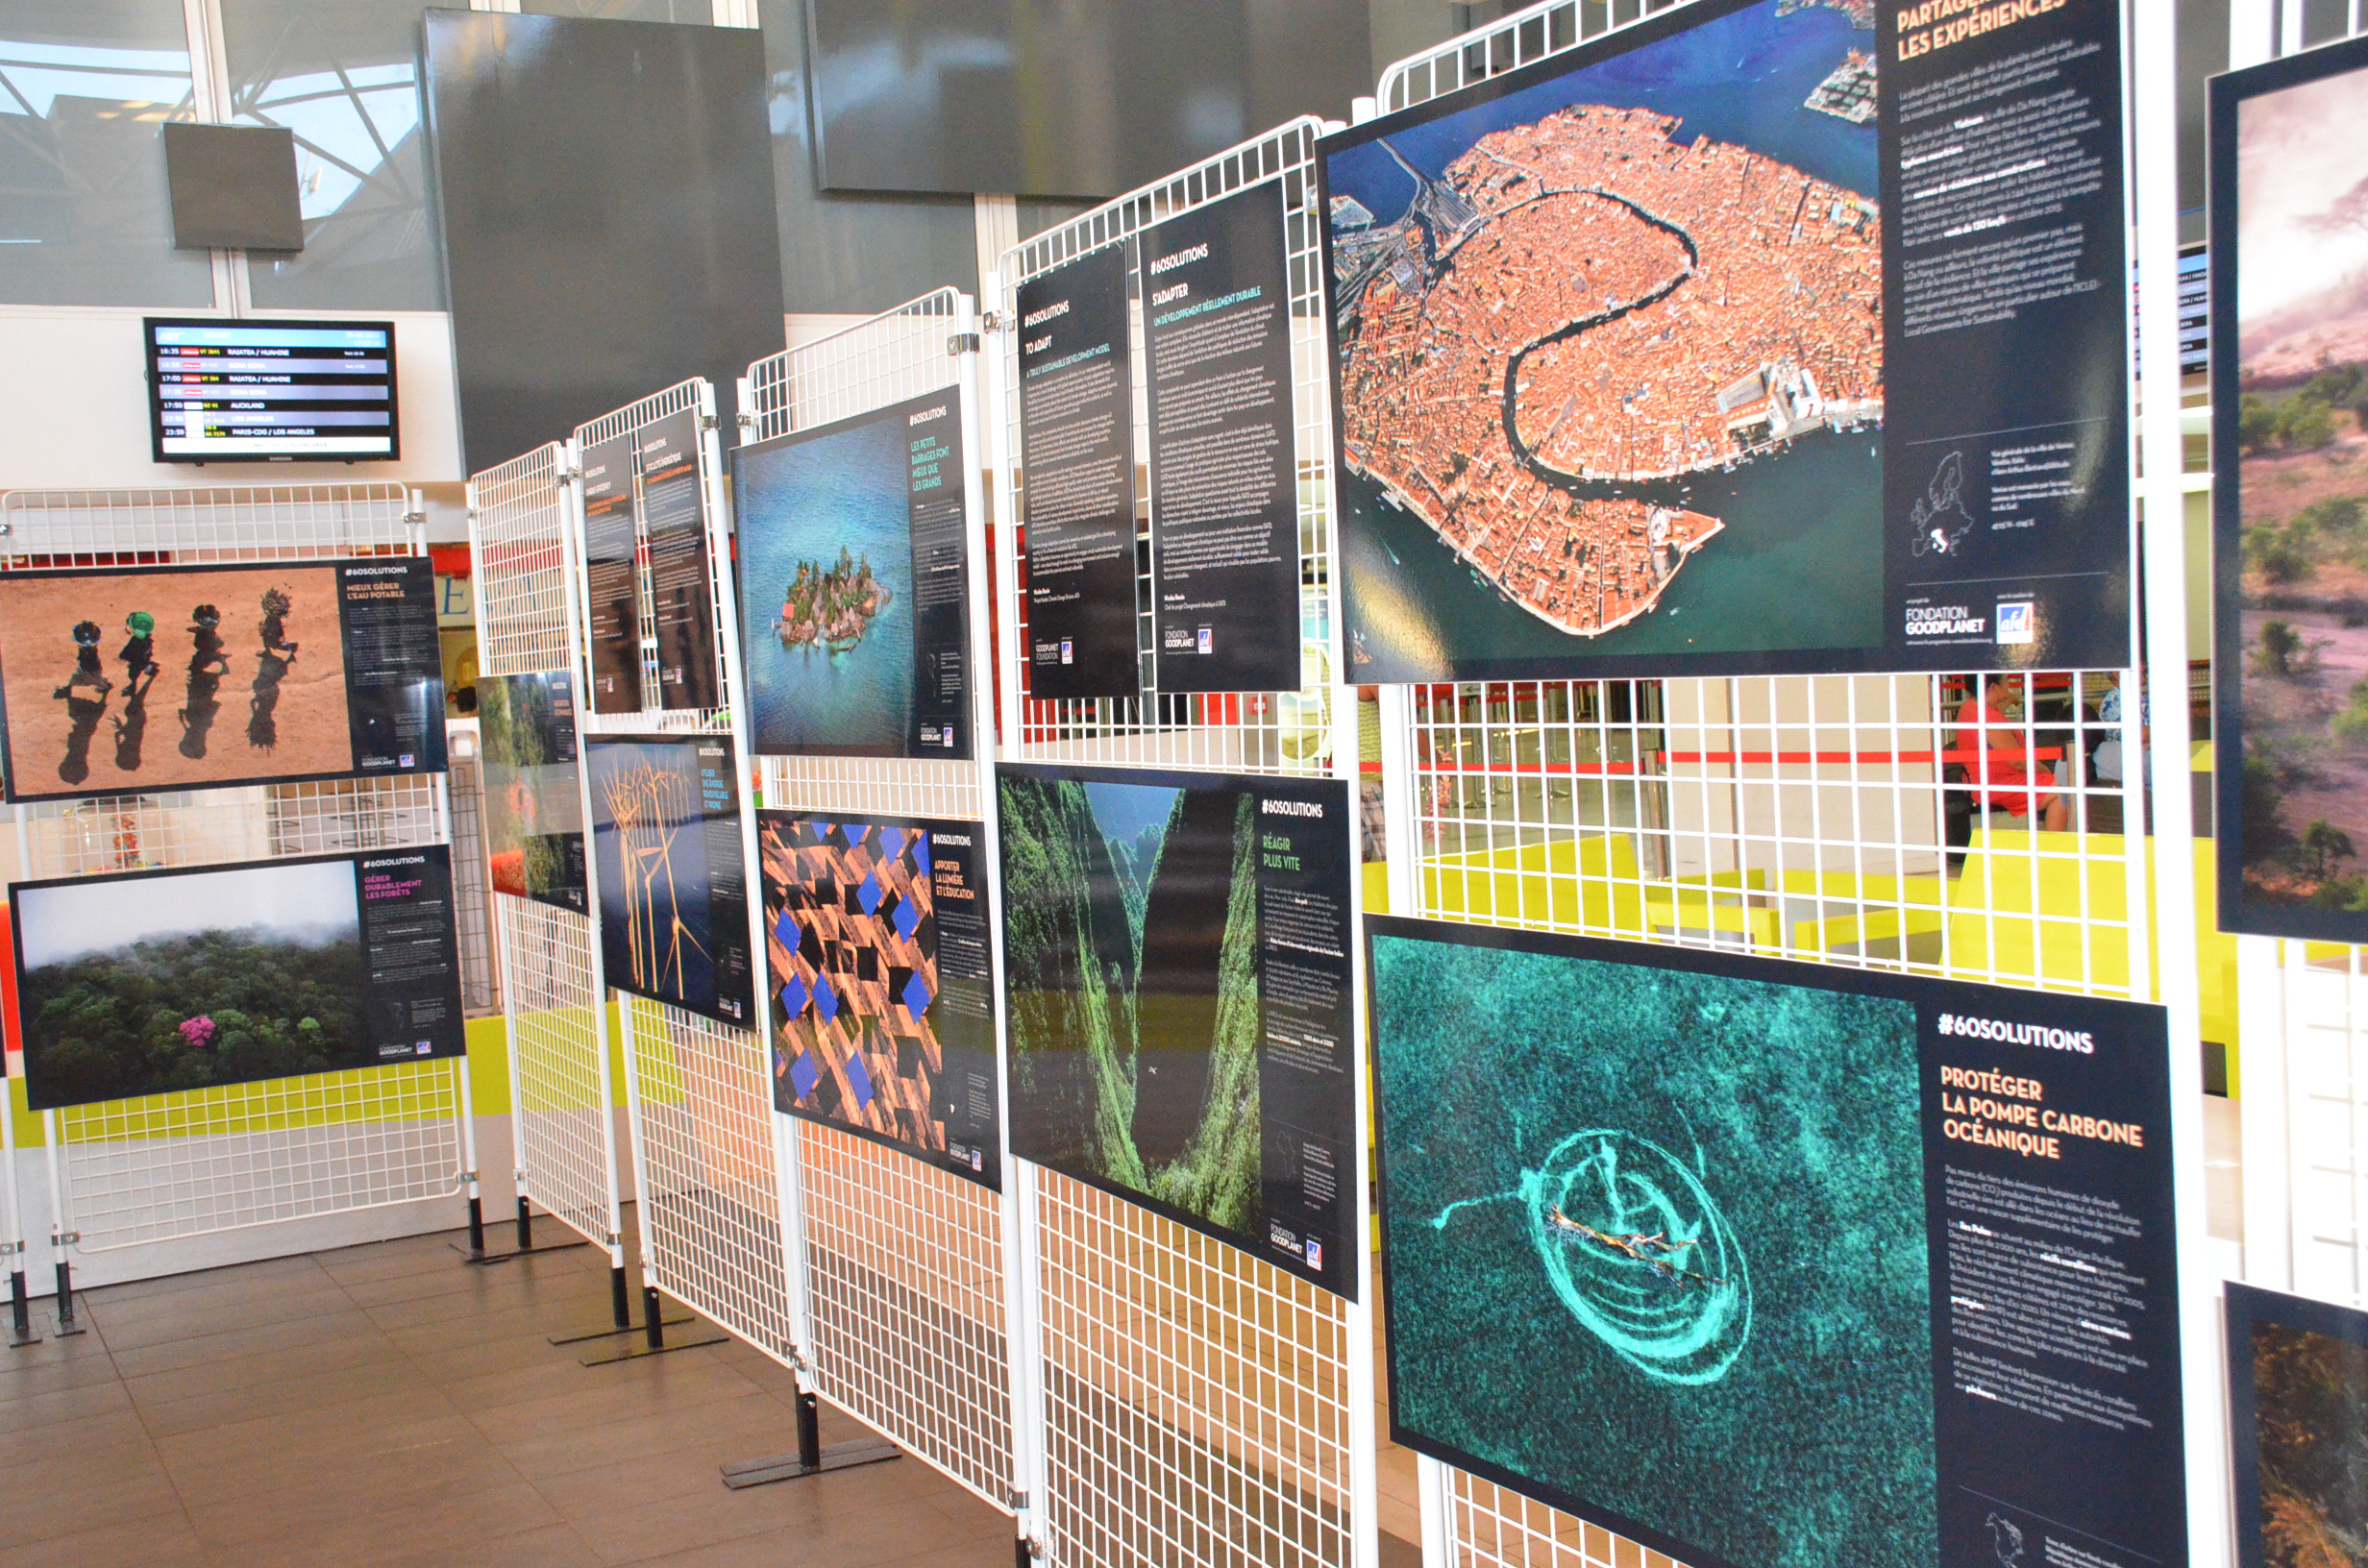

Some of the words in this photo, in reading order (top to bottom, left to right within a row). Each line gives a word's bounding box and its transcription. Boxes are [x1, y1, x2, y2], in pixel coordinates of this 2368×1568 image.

[1897, 0, 1994, 33] PARTAG
[1898, 31, 1931, 61] LES
[1150, 243, 1208, 275] #60SOLUTIONS
[1152, 282, 1189, 306] S'ADAPTER
[1024, 300, 1070, 328] #60SOLUTIONS
[345, 566, 407, 576] #60SOLUTIONS
[1905, 618, 1986, 635] GOODPLANET
[1906, 606, 1968, 622] FONDATION
[1262, 798, 1323, 818] #60SOLUTIONS
[1263, 831, 1291, 852] RÉAGIR
[363, 855, 425, 869] #60SOLUTIONS
[1263, 854, 1282, 869] PLUS
[1283, 856, 1300, 871] VITE
[1937, 1013, 2095, 1055] #60SOLUTIONS
[1940, 1066, 2043, 1102] PROTÉGER
[1942, 1091, 1968, 1115] LA
[1969, 1096, 2039, 1128] POMPE
[2042, 1110, 2144, 1147] CARBONE
[1943, 1117, 2060, 1160] OCÉANIQUE
